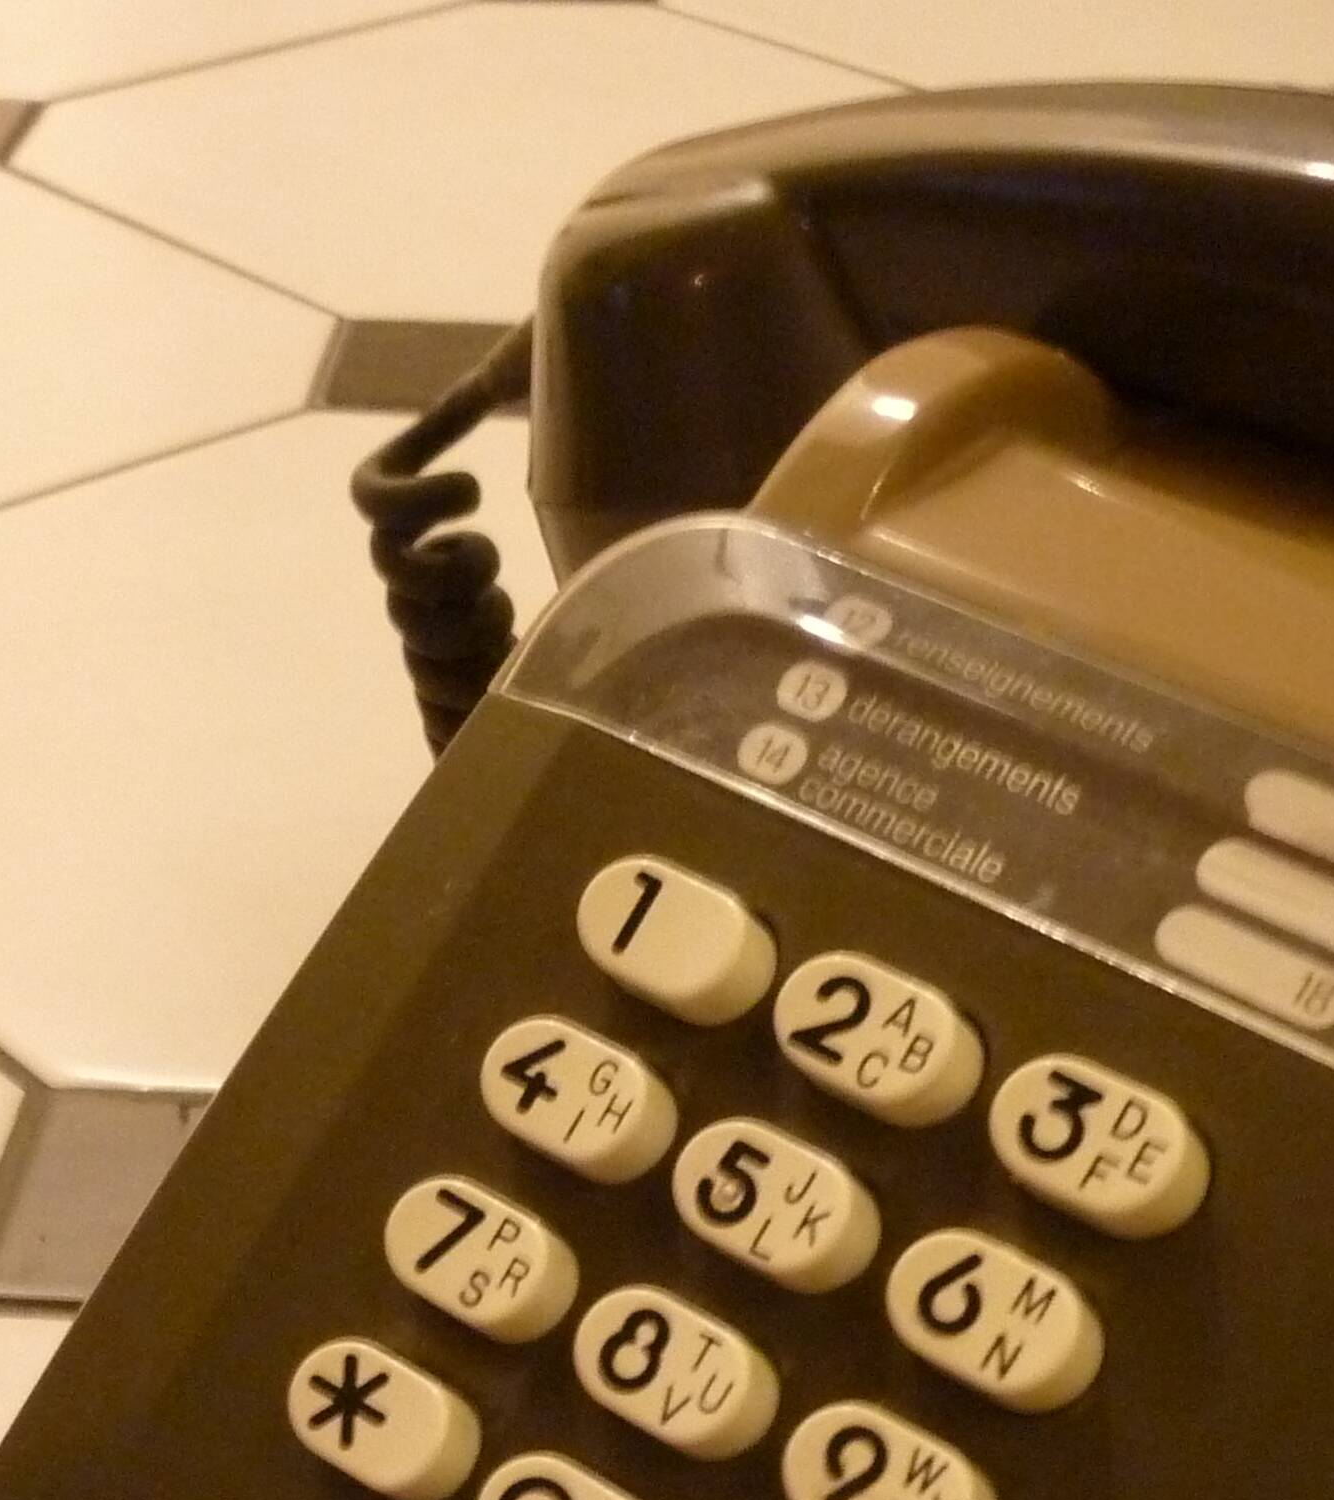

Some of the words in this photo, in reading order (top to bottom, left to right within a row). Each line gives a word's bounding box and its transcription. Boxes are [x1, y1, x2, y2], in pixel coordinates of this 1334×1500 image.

[795, 672, 832, 711] 13
[893, 628, 1156, 754] renseignements
[756, 738, 788, 775] 14
[817, 744, 940, 812] agence
[799, 774, 1006, 884] commerciale
[611, 871, 663, 956] 1
[786, 975, 871, 1065] 2
[500, 1038, 567, 1115] 4
[1018, 1069, 1103, 1161] 3
[695, 1139, 771, 1226] 5
[415, 1187, 486, 1273] 7
[918, 1253, 984, 1336] 6
[598, 1308, 670, 1395] 8
